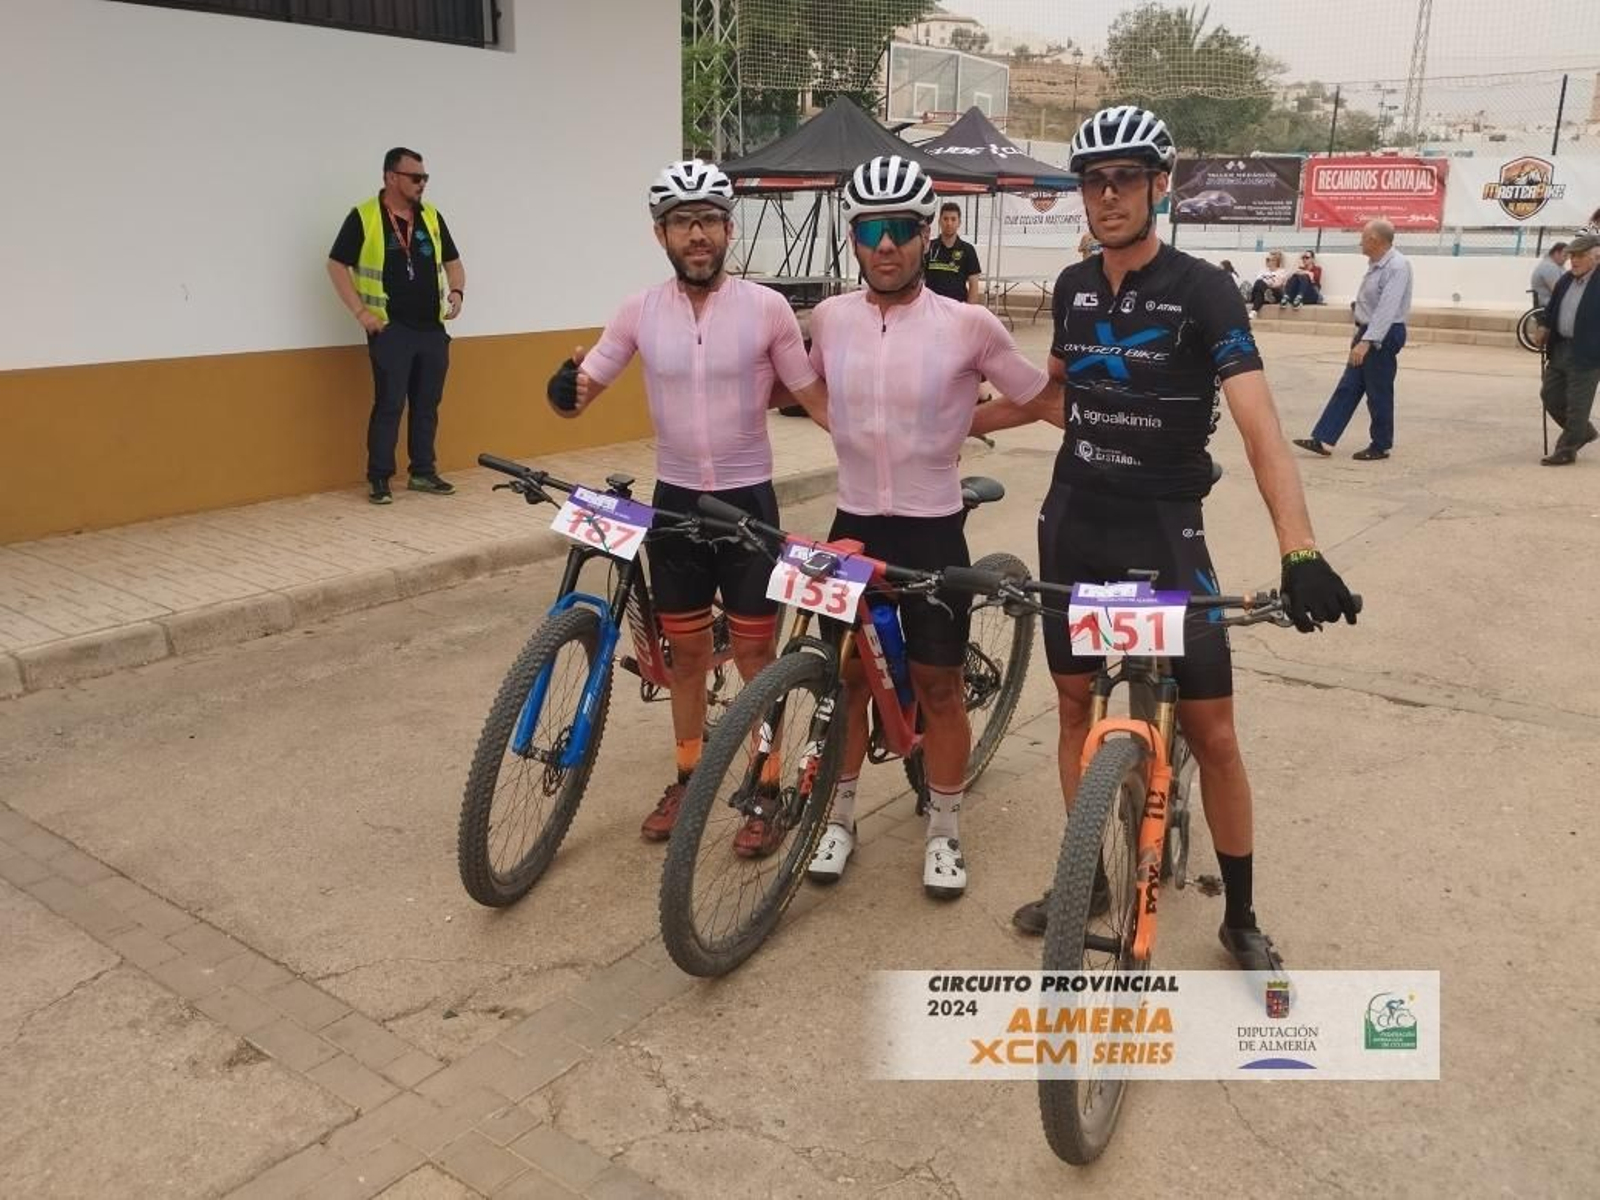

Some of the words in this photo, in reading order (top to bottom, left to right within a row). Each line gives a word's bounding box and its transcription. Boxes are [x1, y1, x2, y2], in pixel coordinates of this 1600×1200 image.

[1318, 169, 1379, 190] RECAMBIOS
[1381, 169, 1433, 193] CARVAJAL
[1063, 344, 1122, 355] OXYGEN
[1124, 349, 1169, 360] BIKE
[1083, 409, 1162, 428] agroalkimia
[781, 564, 851, 617] 153
[1082, 611, 1167, 651] 151
